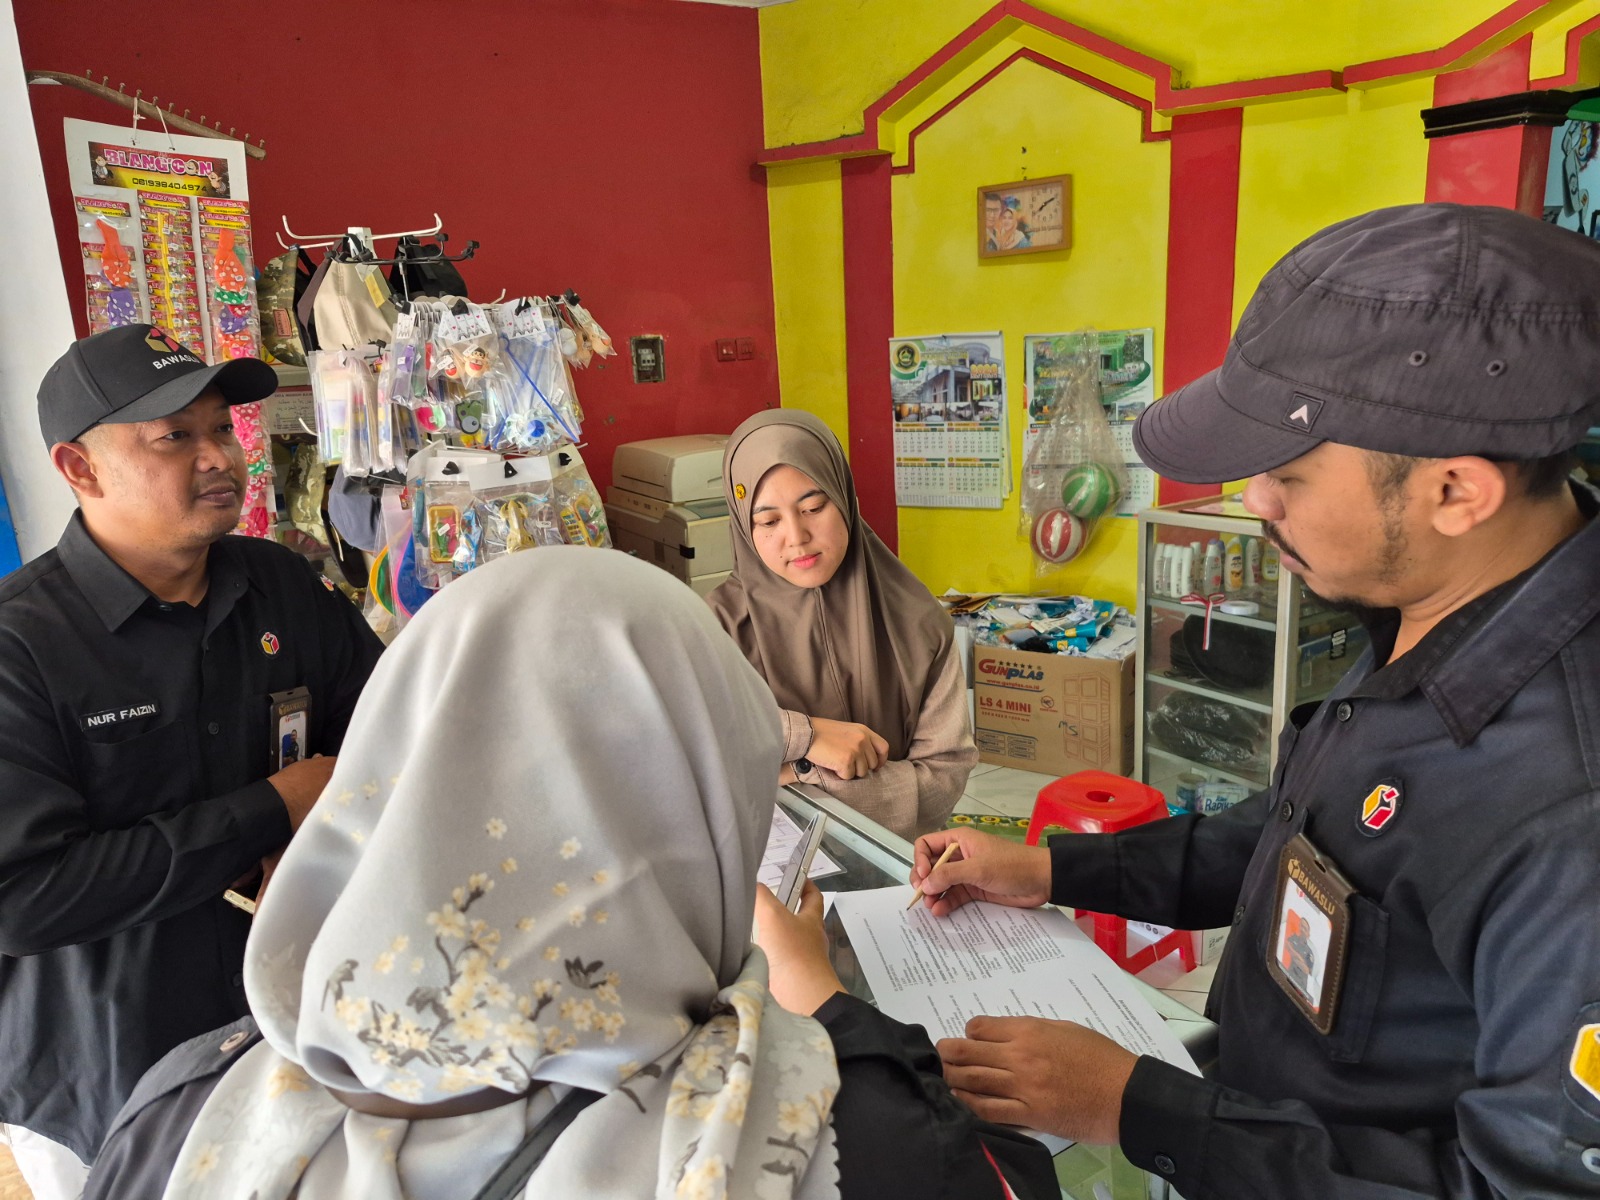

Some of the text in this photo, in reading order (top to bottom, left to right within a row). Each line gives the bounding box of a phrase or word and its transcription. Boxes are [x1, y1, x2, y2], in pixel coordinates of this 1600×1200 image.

[87, 703, 157, 727] NUR FAIZIN
[979, 696, 993, 707] LS
[995, 698, 1003, 709] 4
[1006, 700, 1031, 713] MINI
[1297, 870, 1336, 915] BAWASLU
